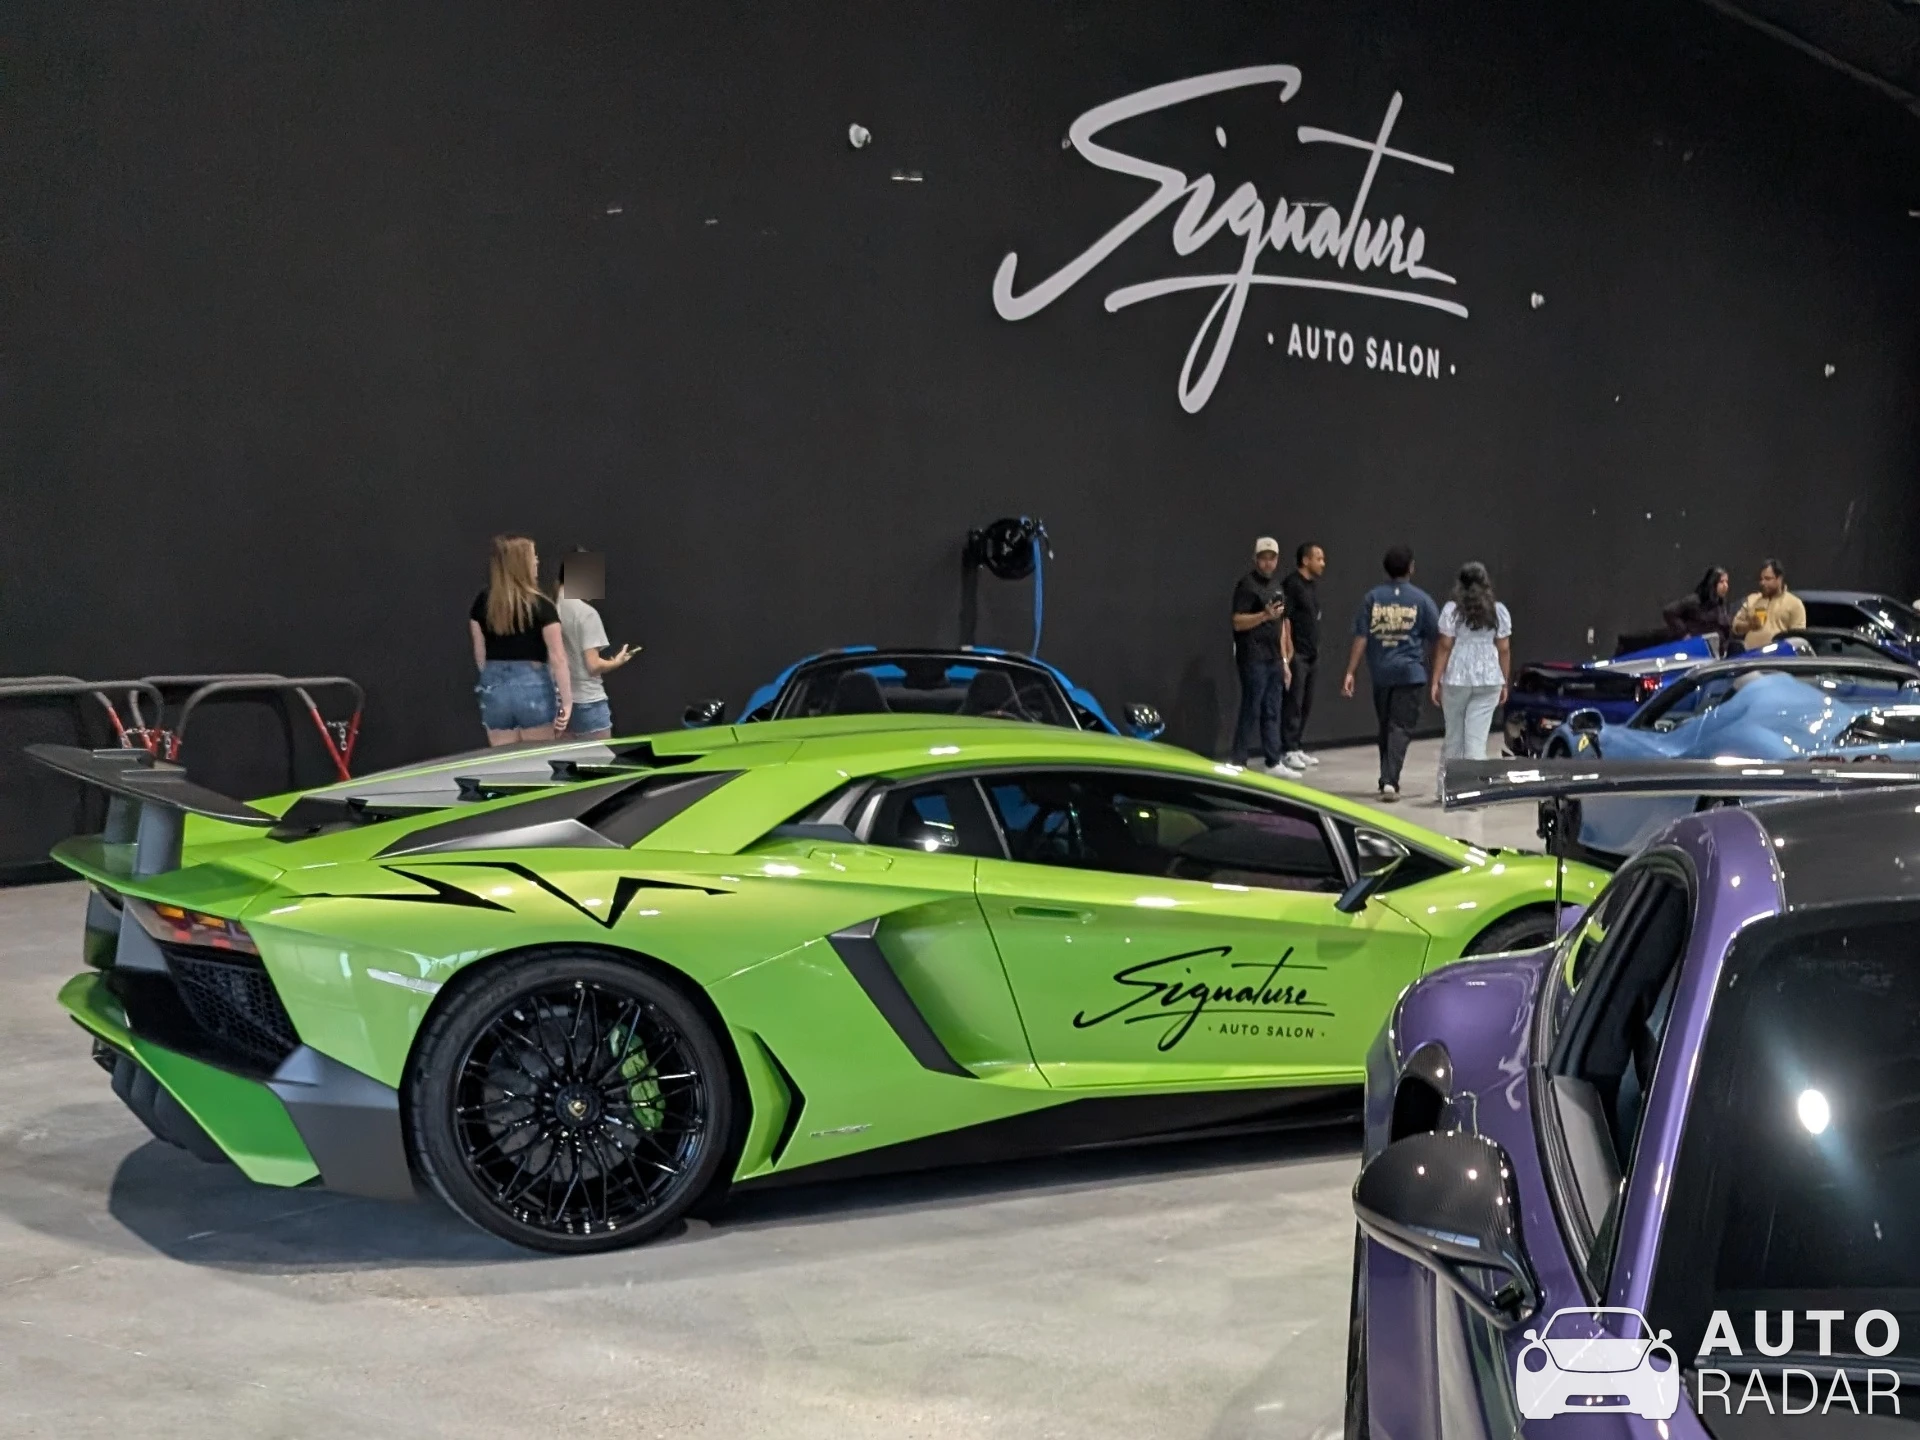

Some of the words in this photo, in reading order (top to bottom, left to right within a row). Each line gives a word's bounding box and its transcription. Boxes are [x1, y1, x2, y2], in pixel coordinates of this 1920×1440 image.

[993, 64, 1459, 414] Signature
[1287, 323, 1355, 366] AUTO
[1365, 337, 1441, 379] SALON
[1073, 946, 1329, 1052] Signature
[1219, 1024, 1260, 1037] AUTO
[1266, 1026, 1315, 1039] SALON
